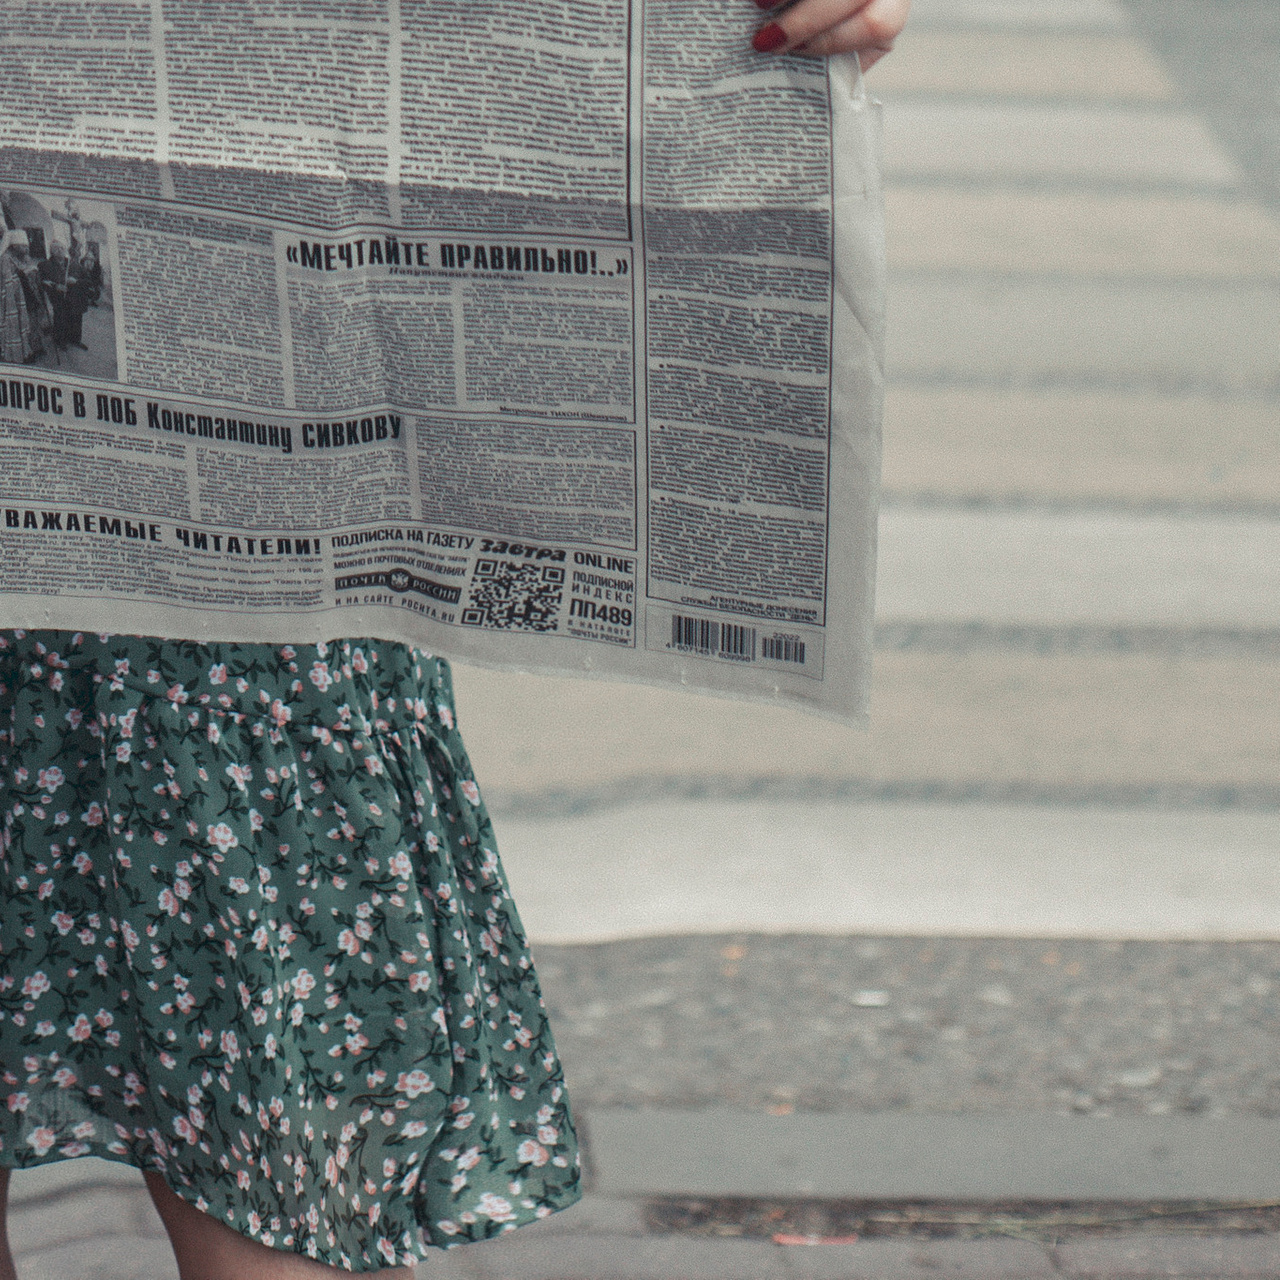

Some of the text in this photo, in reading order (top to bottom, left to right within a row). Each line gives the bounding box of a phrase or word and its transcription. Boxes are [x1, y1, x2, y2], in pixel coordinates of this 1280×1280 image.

[286, 235, 629, 277] «МЕЧТАЙТЕ ПРАВИЛЬНО!..»
[72, 390, 87, 419] В
[95, 393, 138, 427] ЛОБ
[146, 401, 293, 454] Константину
[301, 413, 402, 449] СИВКОВУ
[175, 527, 321, 556] ЧИТАТЕЛИ!
[331, 528, 634, 574] ПОДПИСКА НА ГАЗЕТУ завтра ONLINE
[571, 582, 633, 604] ИНДЕКС
[572, 570, 634, 593] ПОДПИСНОЙ
[346, 596, 359, 605] НА
[363, 593, 394, 604] САЙТЕ
[569, 597, 632, 627] ПП489
